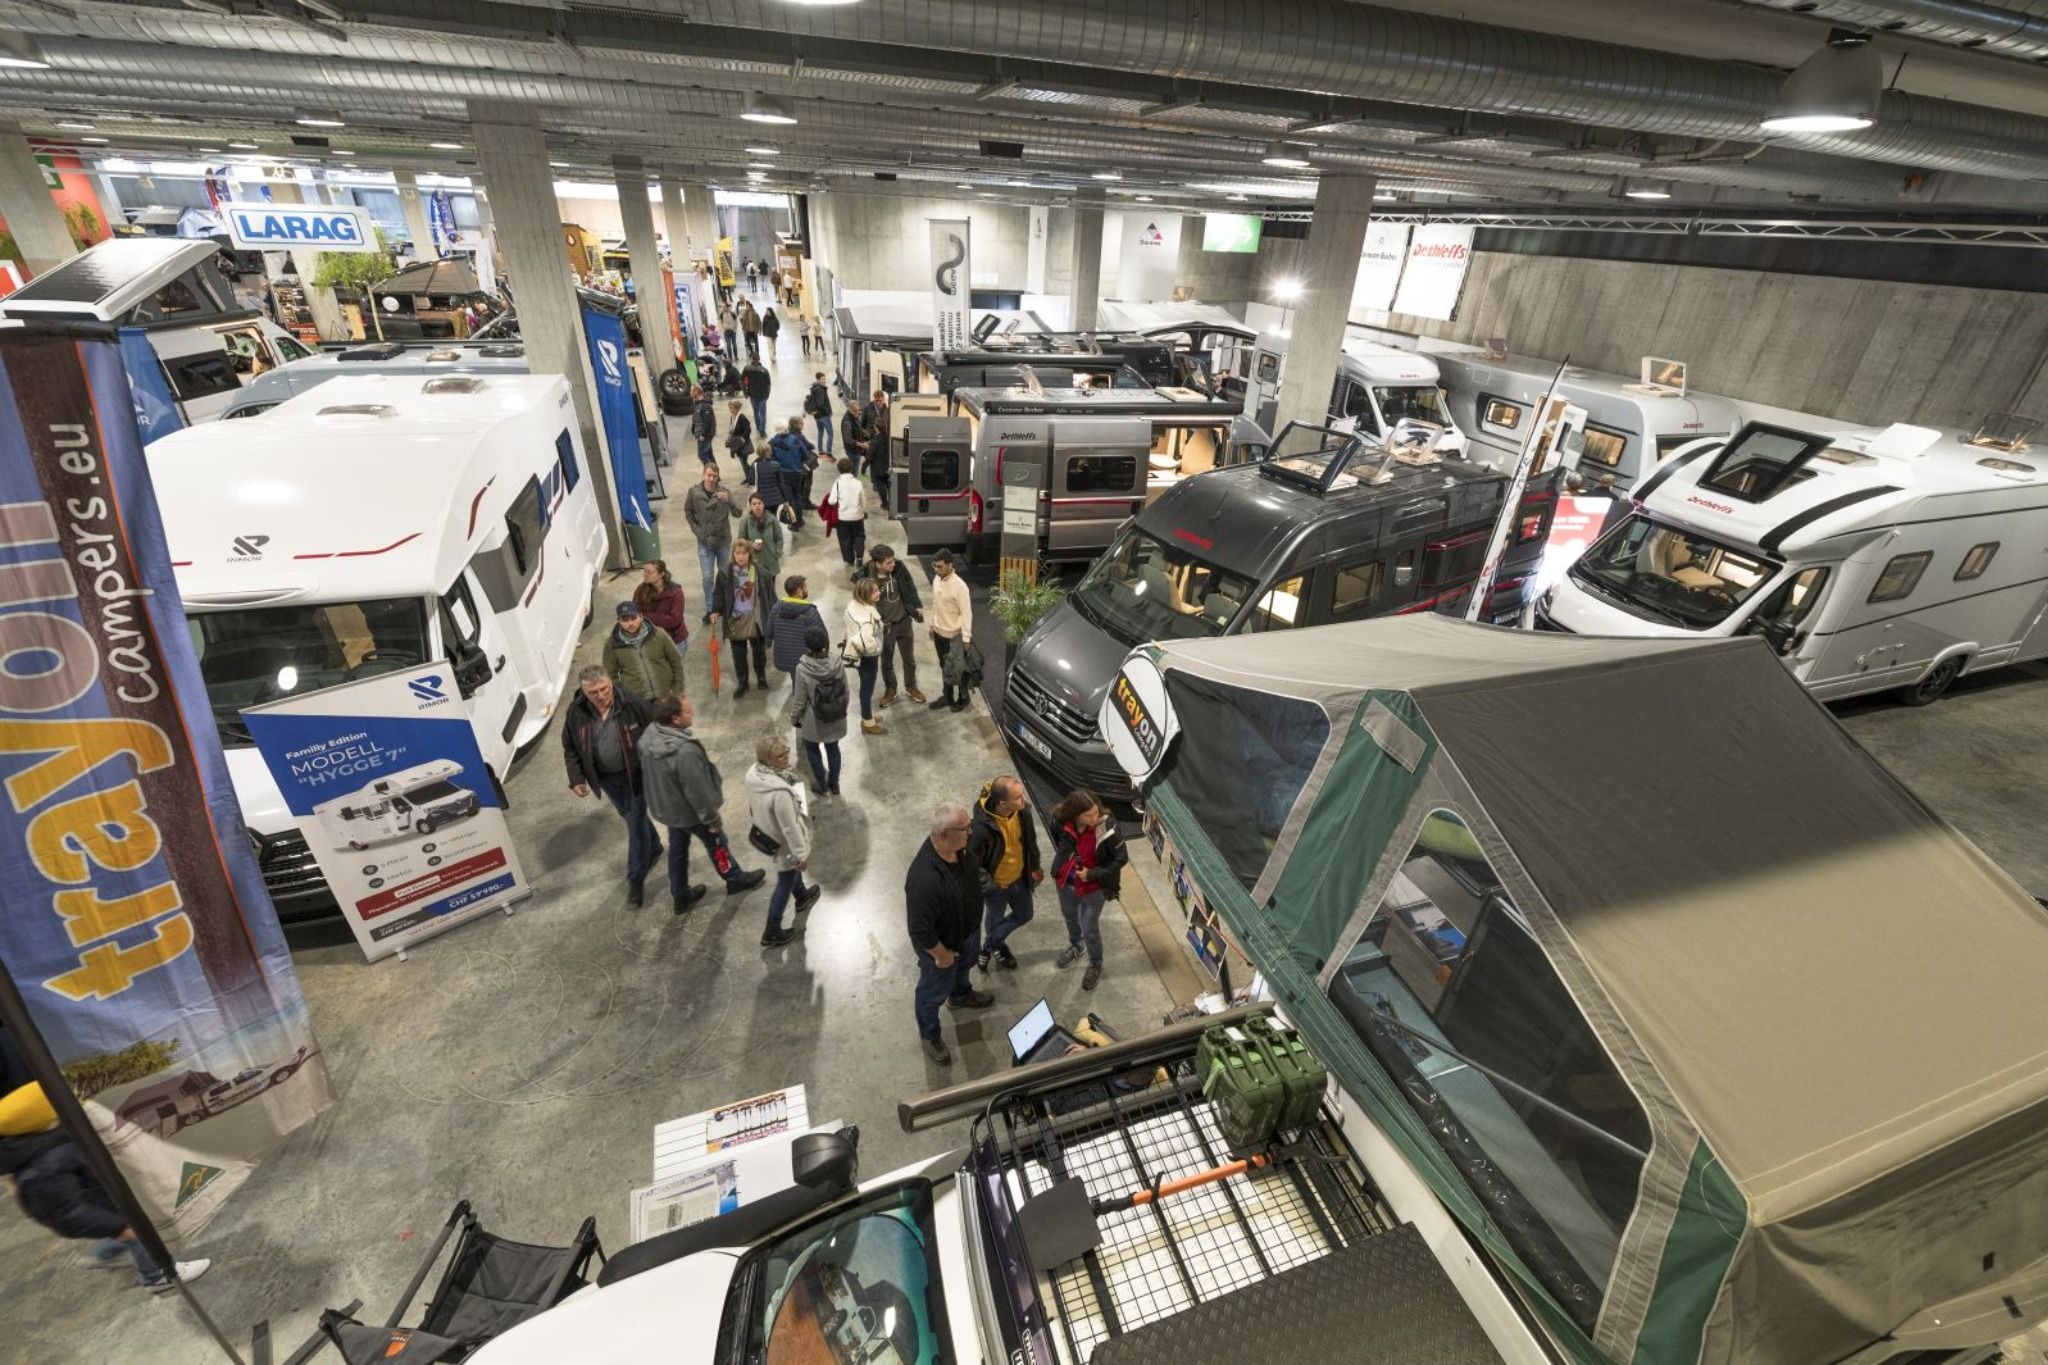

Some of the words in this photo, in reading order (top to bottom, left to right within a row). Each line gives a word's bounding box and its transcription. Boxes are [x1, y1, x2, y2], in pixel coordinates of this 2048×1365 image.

[239, 215, 357, 240] LARAG
[1413, 242, 1467, 260] Dethleffs
[418, 697, 450, 710] RIMOR
[1117, 677, 1157, 750] trayon
[328, 731, 368, 747] Edition
[291, 741, 384, 776] MODELL
[449, 895, 469, 908] CHF
